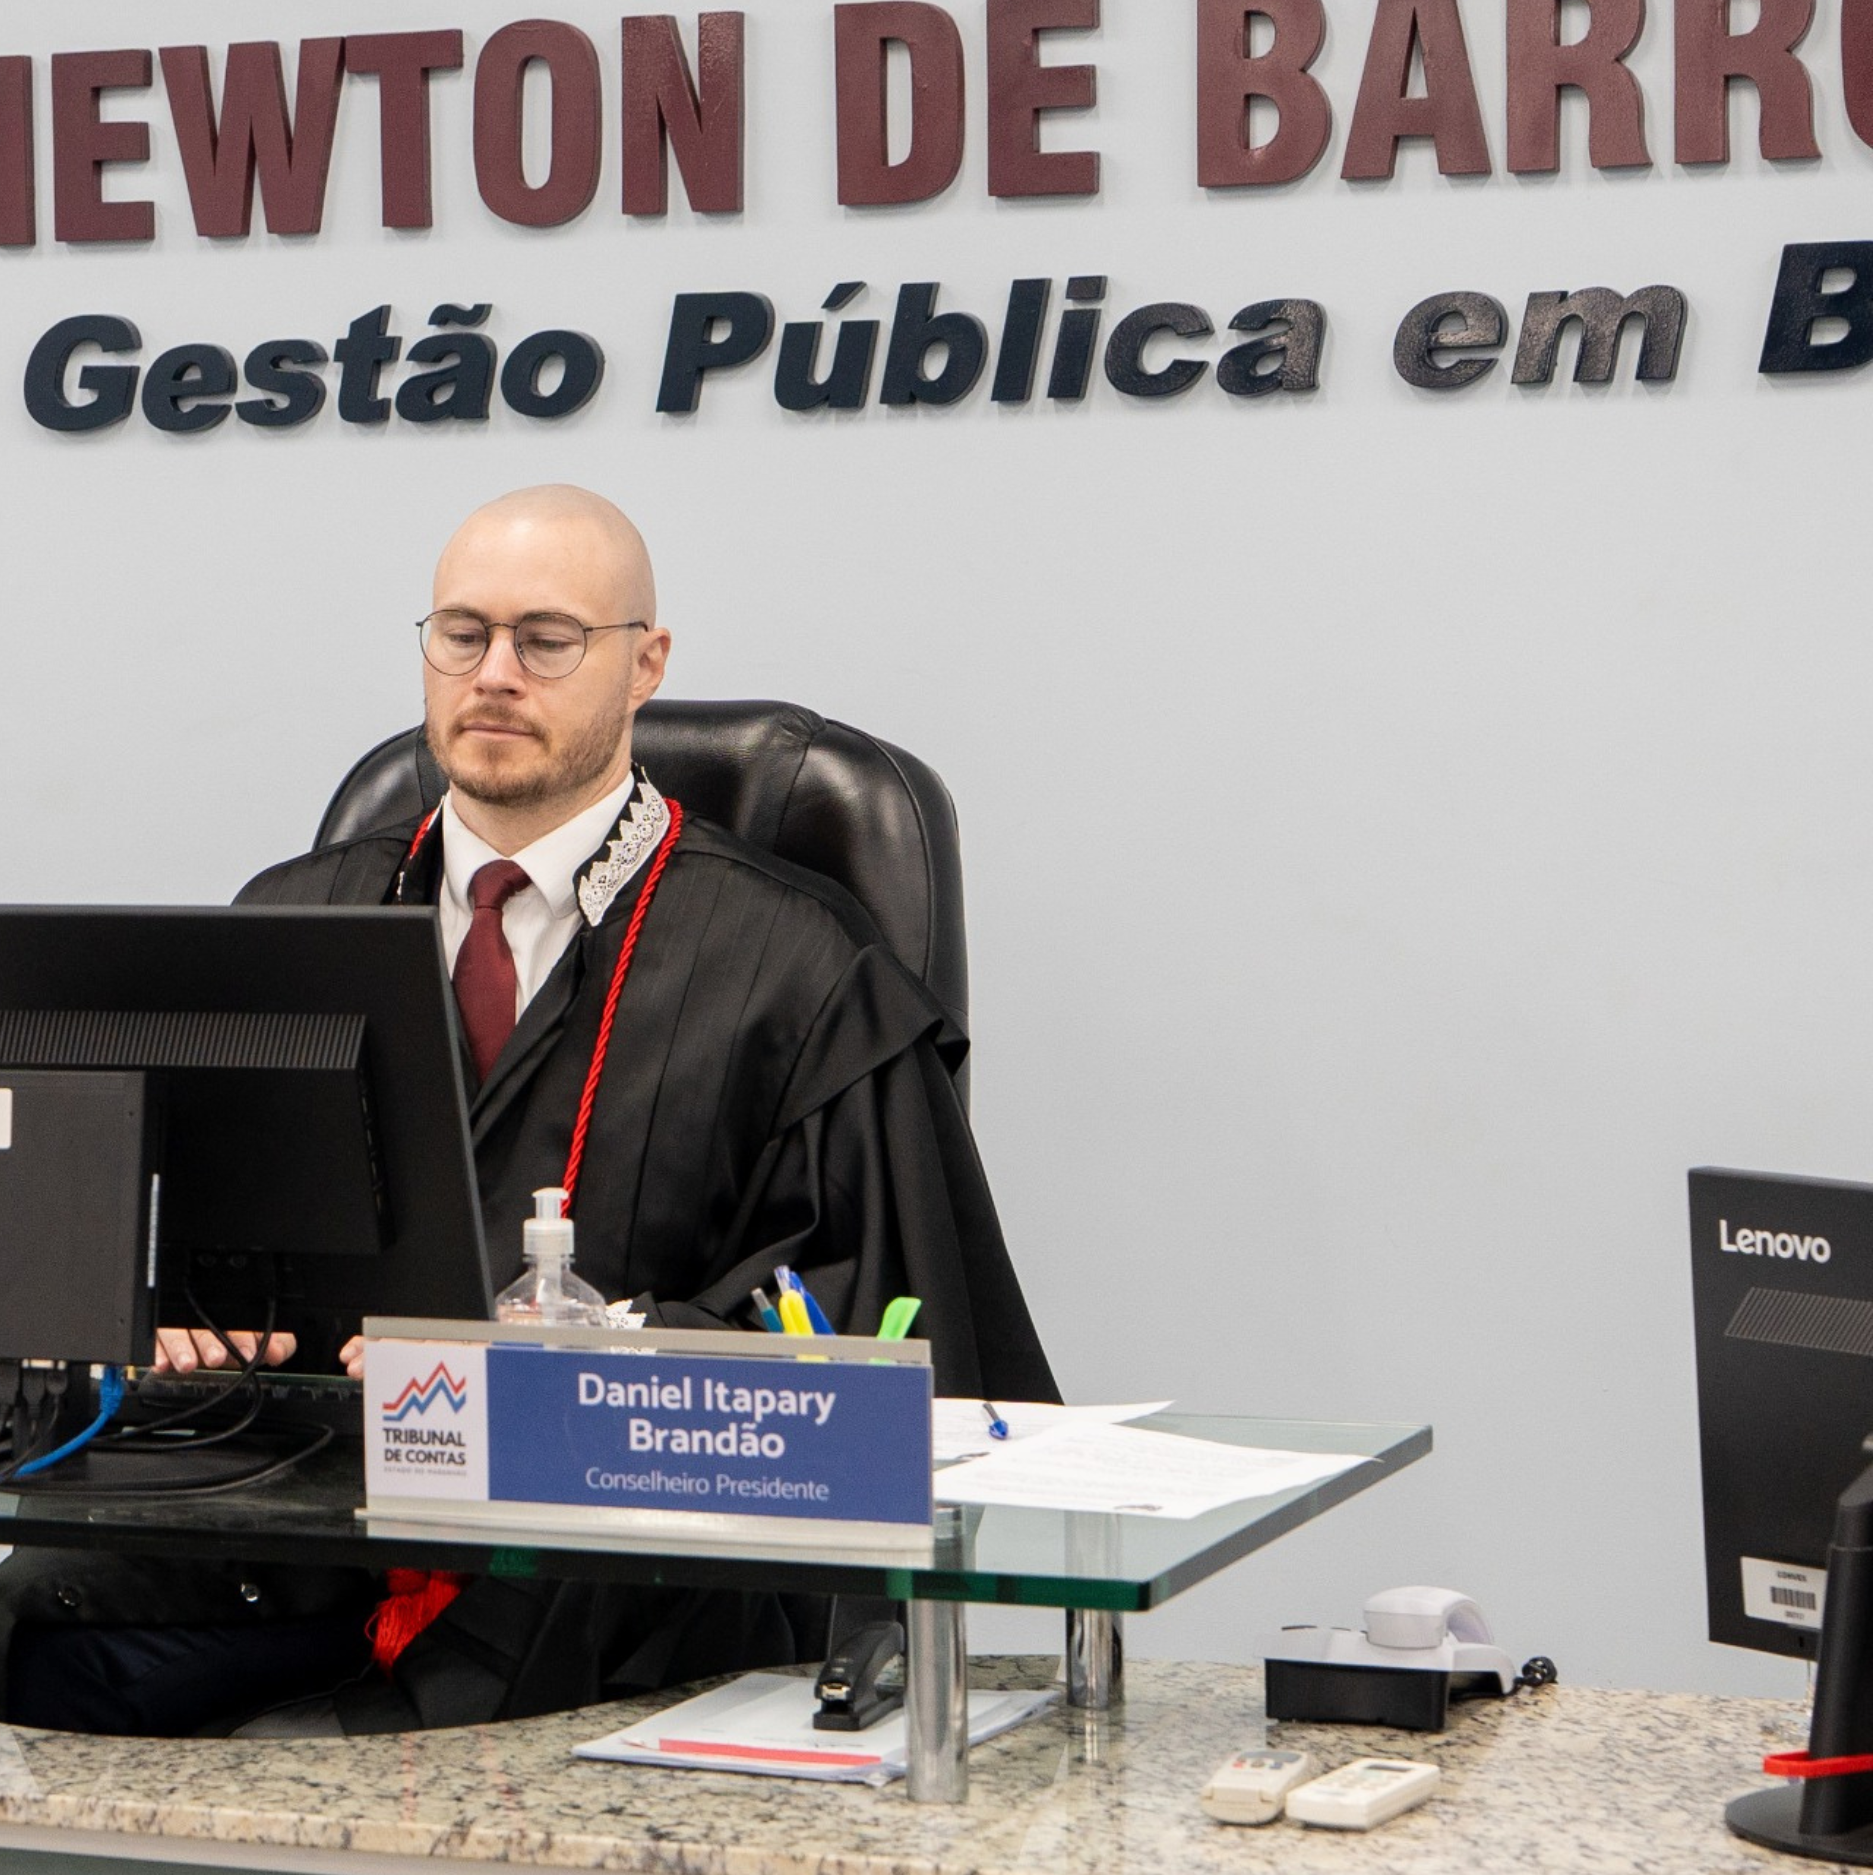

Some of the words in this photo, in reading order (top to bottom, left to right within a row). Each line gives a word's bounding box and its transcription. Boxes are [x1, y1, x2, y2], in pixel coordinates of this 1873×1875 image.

[834, 0, 1100, 206] DE
[1197, 0, 1873, 187] BARR
[24, 303, 605, 434] Gestão
[656, 276, 1327, 413] Pública
[1393, 285, 1688, 389] em
[1719, 1219, 1831, 1264] Lenovo
[578, 1372, 692, 1412] Daniel
[703, 1378, 837, 1426] Itapary
[382, 1427, 466, 1447] TRIBUNAL
[384, 1449, 402, 1462] DE
[405, 1449, 466, 1466] CONTAS
[629, 1418, 785, 1459] Brandão
[585, 1467, 710, 1494] Conselheiro
[716, 1474, 829, 1501] Presidente
